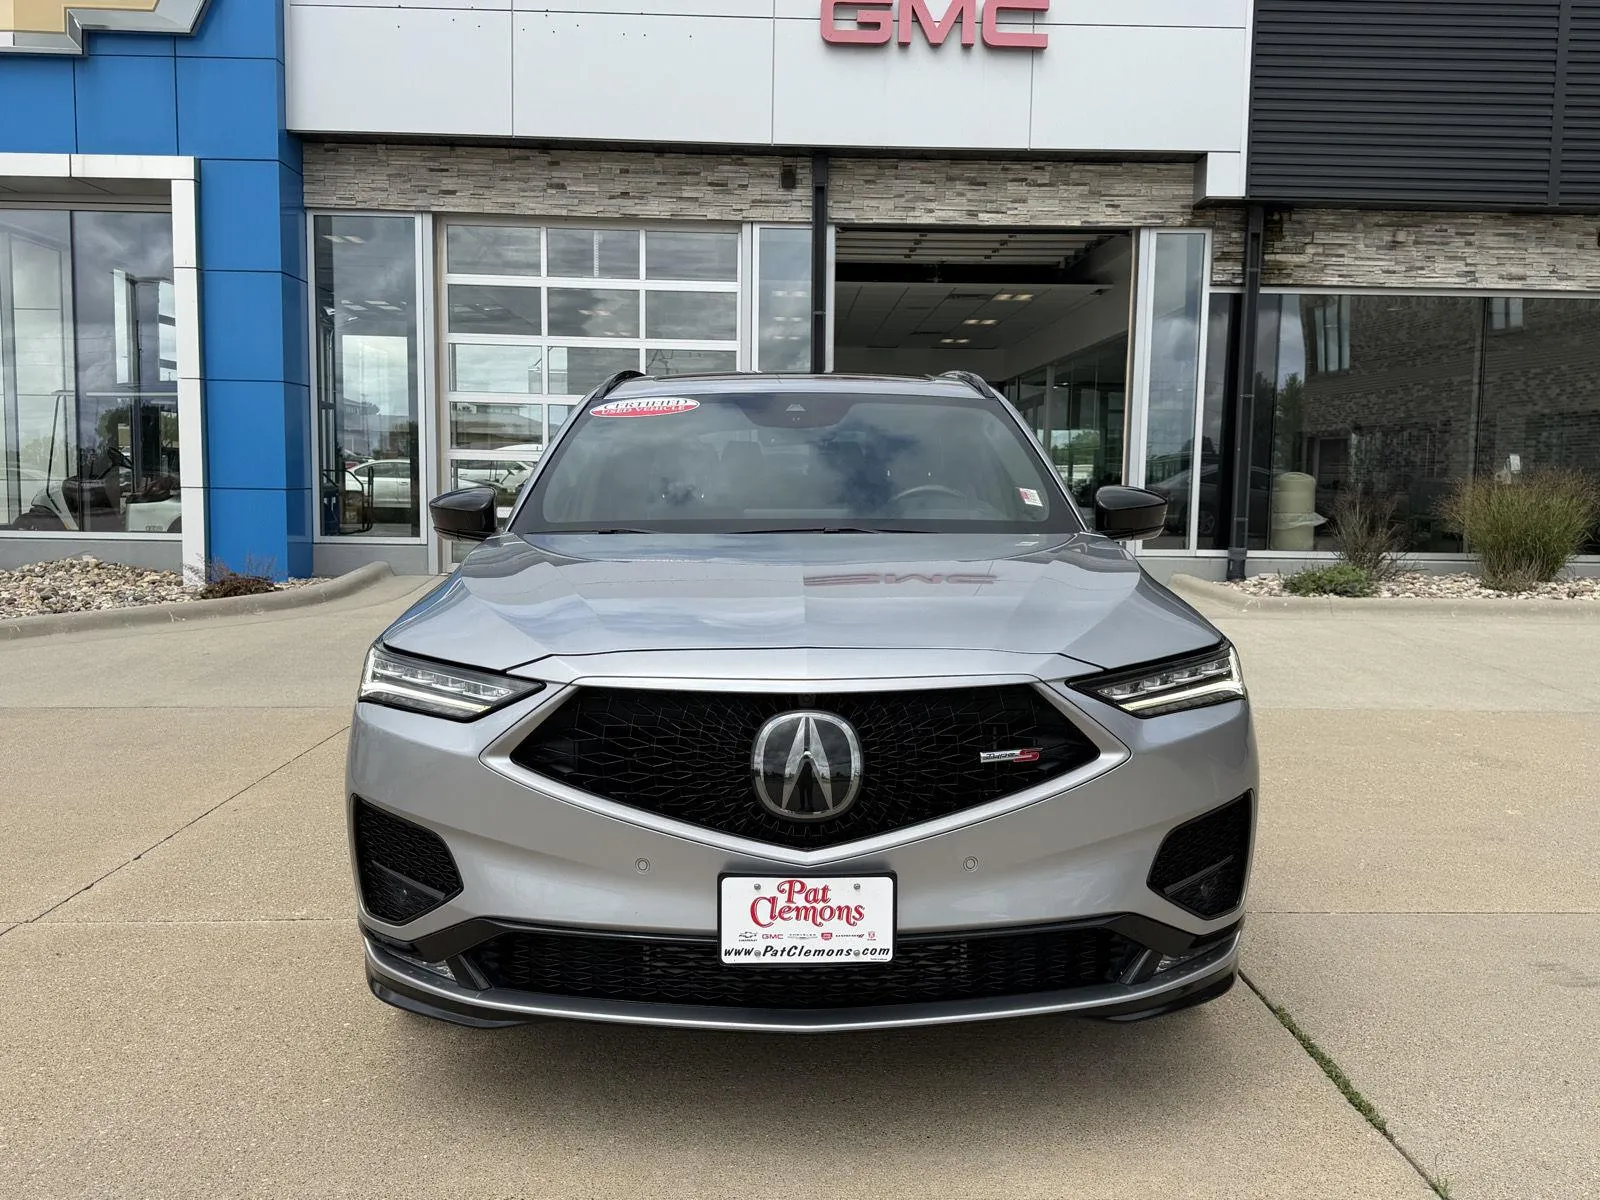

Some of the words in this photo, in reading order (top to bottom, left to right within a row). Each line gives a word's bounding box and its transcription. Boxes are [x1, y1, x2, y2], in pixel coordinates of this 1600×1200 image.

[820, 0, 1049, 49] GMC
[776, 879, 832, 905] Pat
[750, 896, 866, 928] Clemons
[724, 945, 890, 957] wwwPatClemonscom
